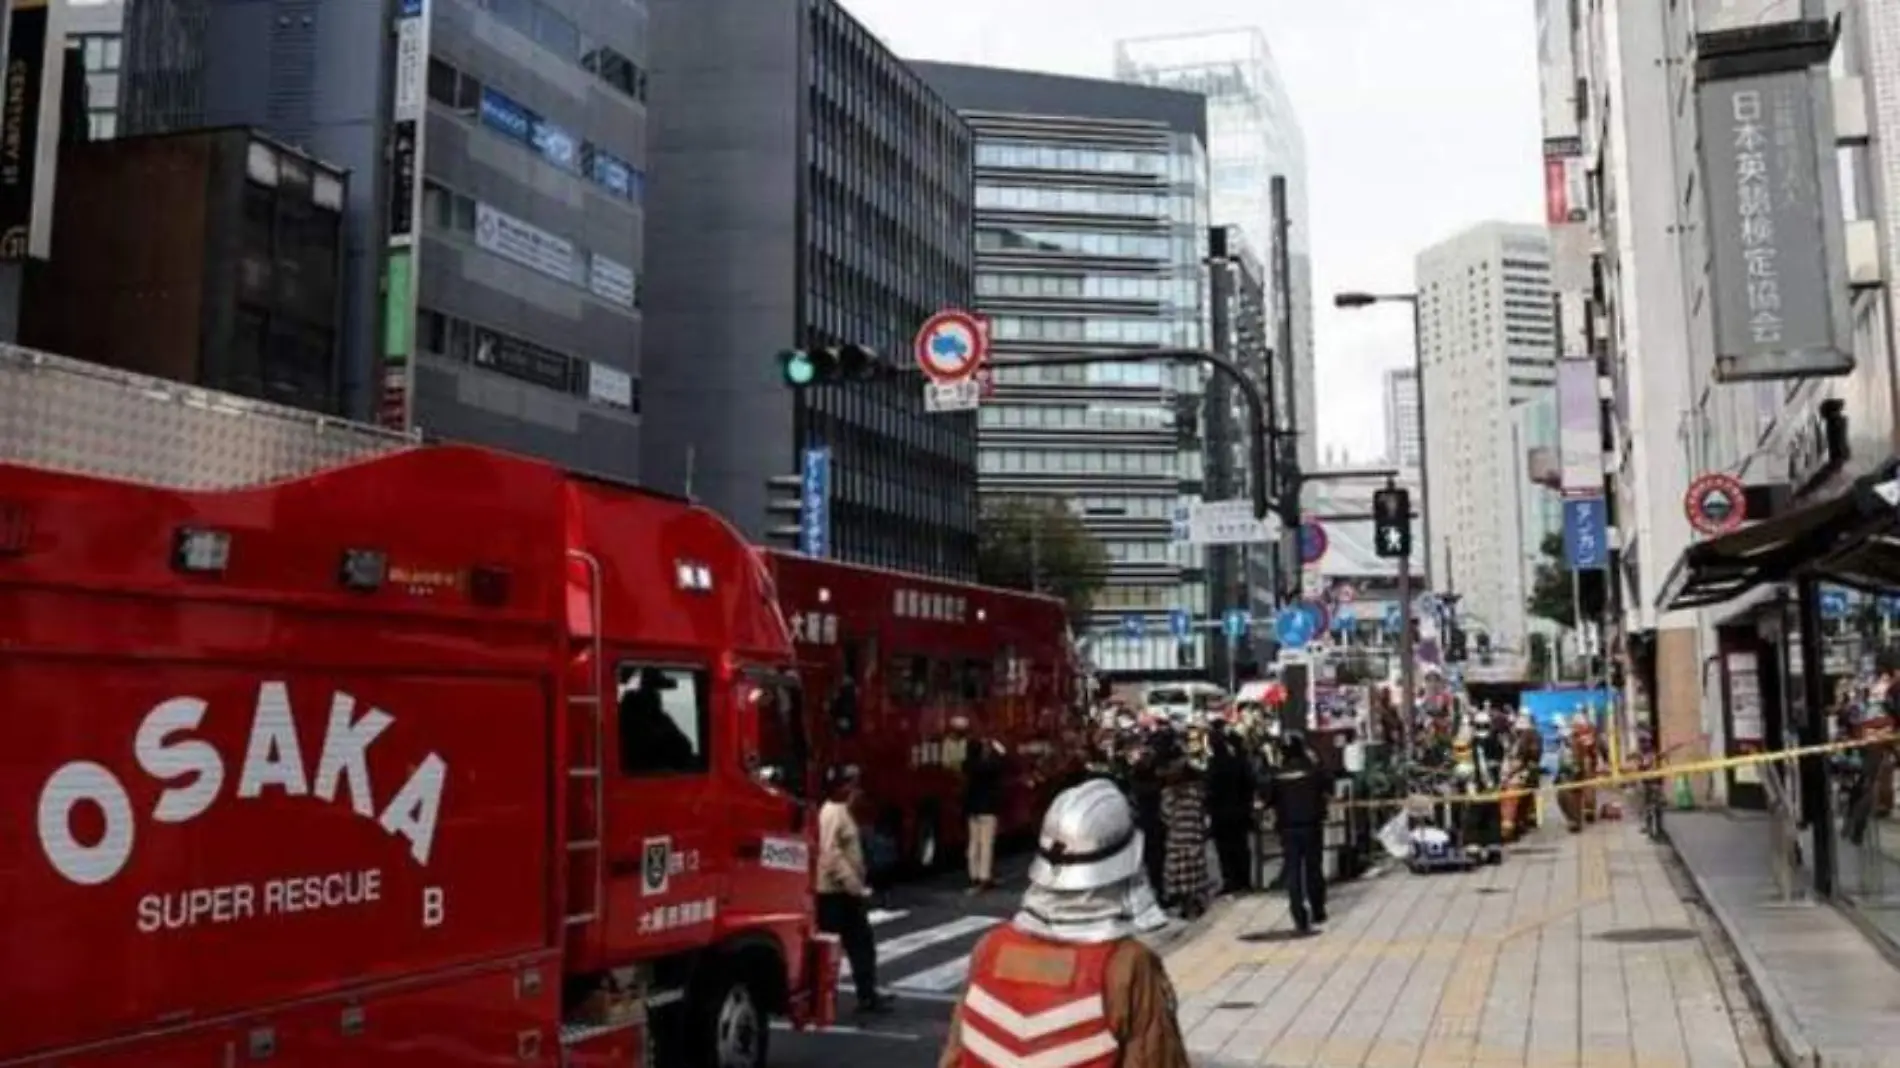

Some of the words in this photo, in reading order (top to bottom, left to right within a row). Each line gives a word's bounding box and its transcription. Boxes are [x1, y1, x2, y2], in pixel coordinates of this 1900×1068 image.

[38, 681, 447, 885] OSAKA
[137, 884, 254, 932] SUPER
[264, 869, 381, 918] RESCUE
[422, 886, 445, 927] B
